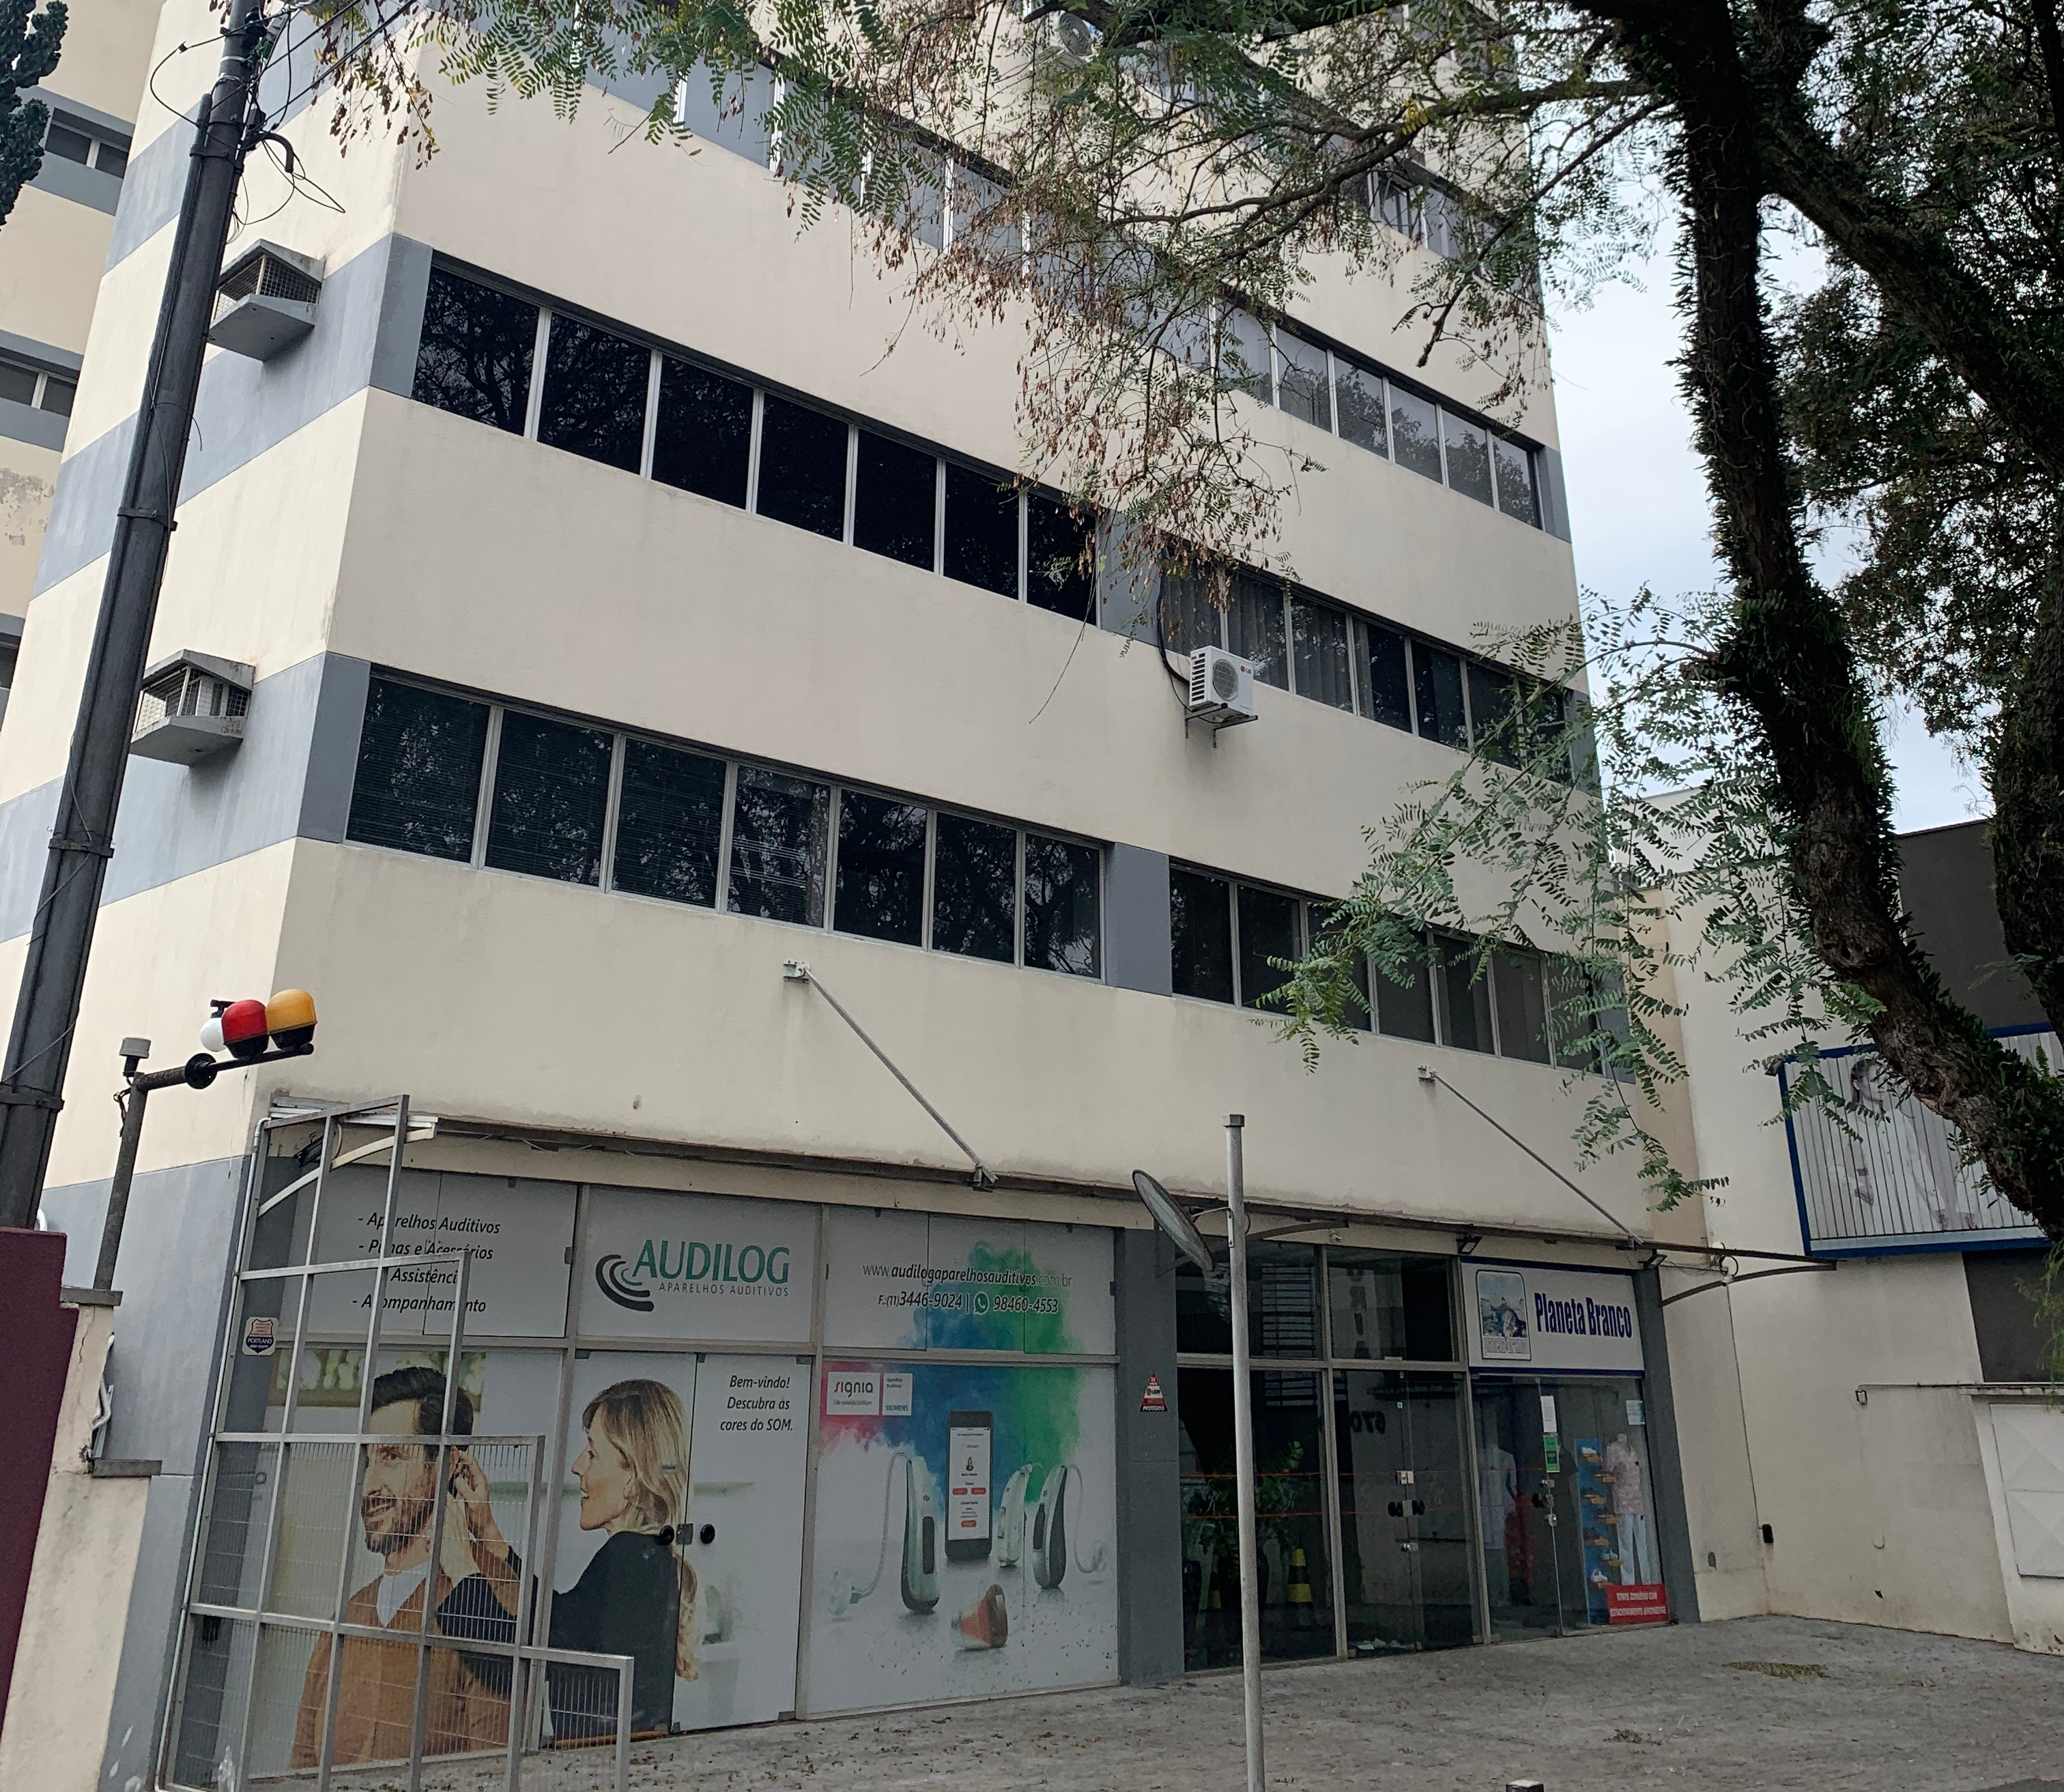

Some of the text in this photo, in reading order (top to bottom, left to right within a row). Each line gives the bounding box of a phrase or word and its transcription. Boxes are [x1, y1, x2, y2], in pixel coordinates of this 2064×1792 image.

[367, 1212, 436, 1230] Aprelhos
[439, 1217, 501, 1234] Auditivos
[414, 1245, 422, 1256] e
[631, 1239, 790, 1284] AUDILOG
[390, 1268, 459, 1284] Assistênci
[862, 1263, 1072, 1288] www.audilogaparelhosauditivos.com.br
[659, 1282, 788, 1297] APARELHOS AUDITIVOS
[993, 1296, 1059, 1313] 98460-4553
[1534, 1292, 1633, 1339] Planeta Branco
[730, 1375, 790, 1389] Bem-vindo!
[834, 1381, 874, 1398] signia
[727, 1396, 775, 1410] Descubra
[720, 1419, 794, 1432] cores do SOM.
